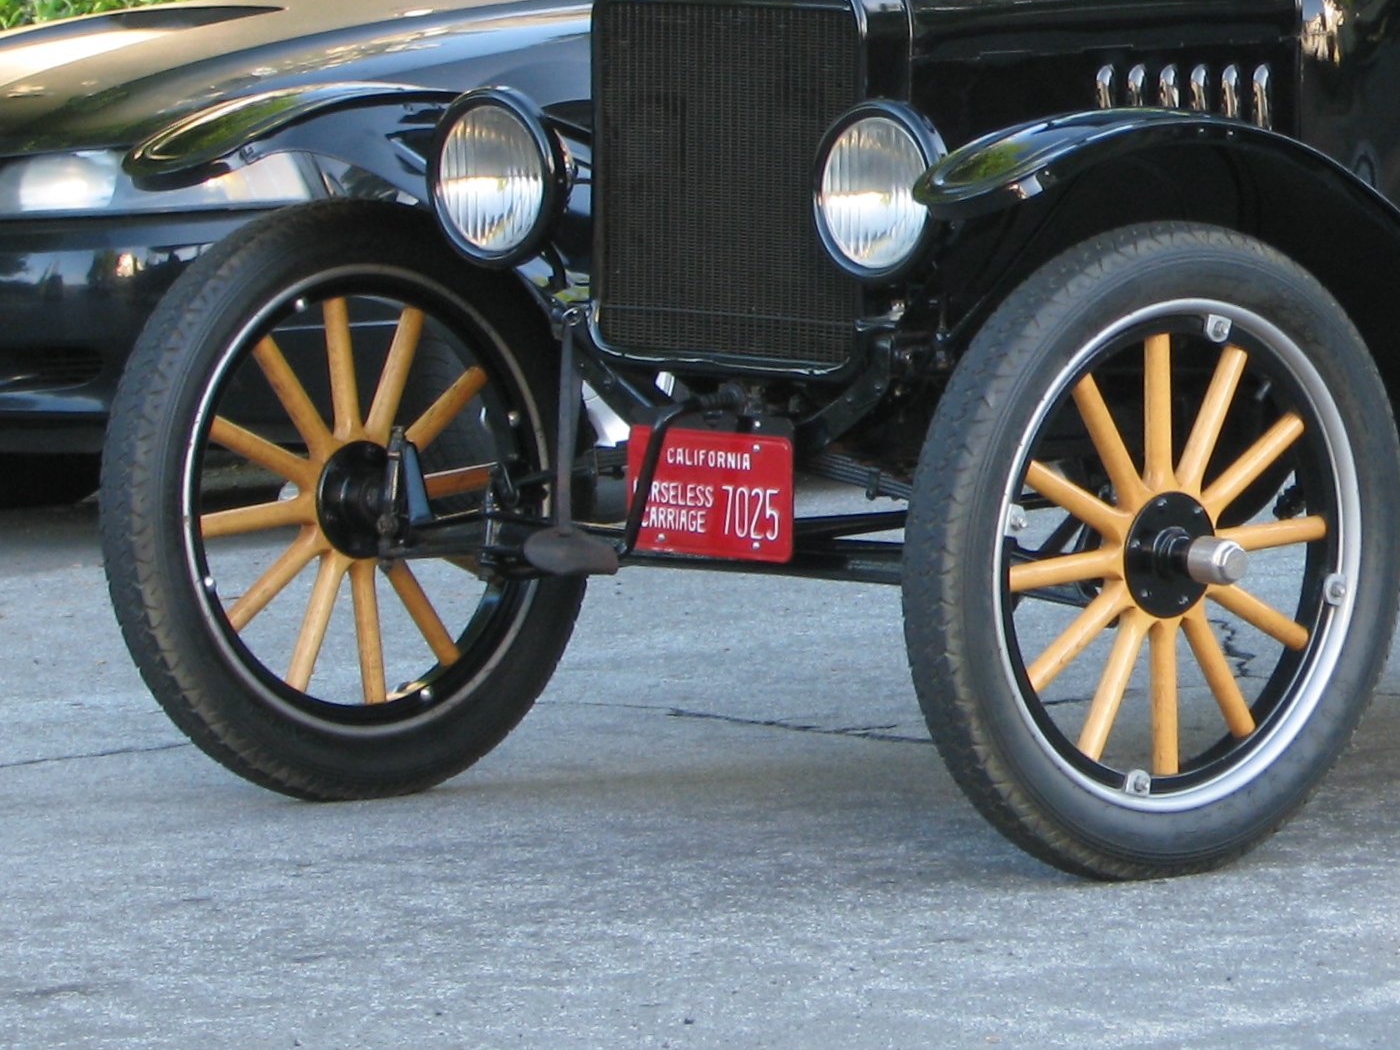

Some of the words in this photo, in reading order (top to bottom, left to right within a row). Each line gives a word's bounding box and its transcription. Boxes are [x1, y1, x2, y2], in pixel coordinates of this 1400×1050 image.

[666, 448, 751, 470] CALIFORNIA
[633, 477, 714, 508] RSELESS
[721, 485, 780, 541] 7025
